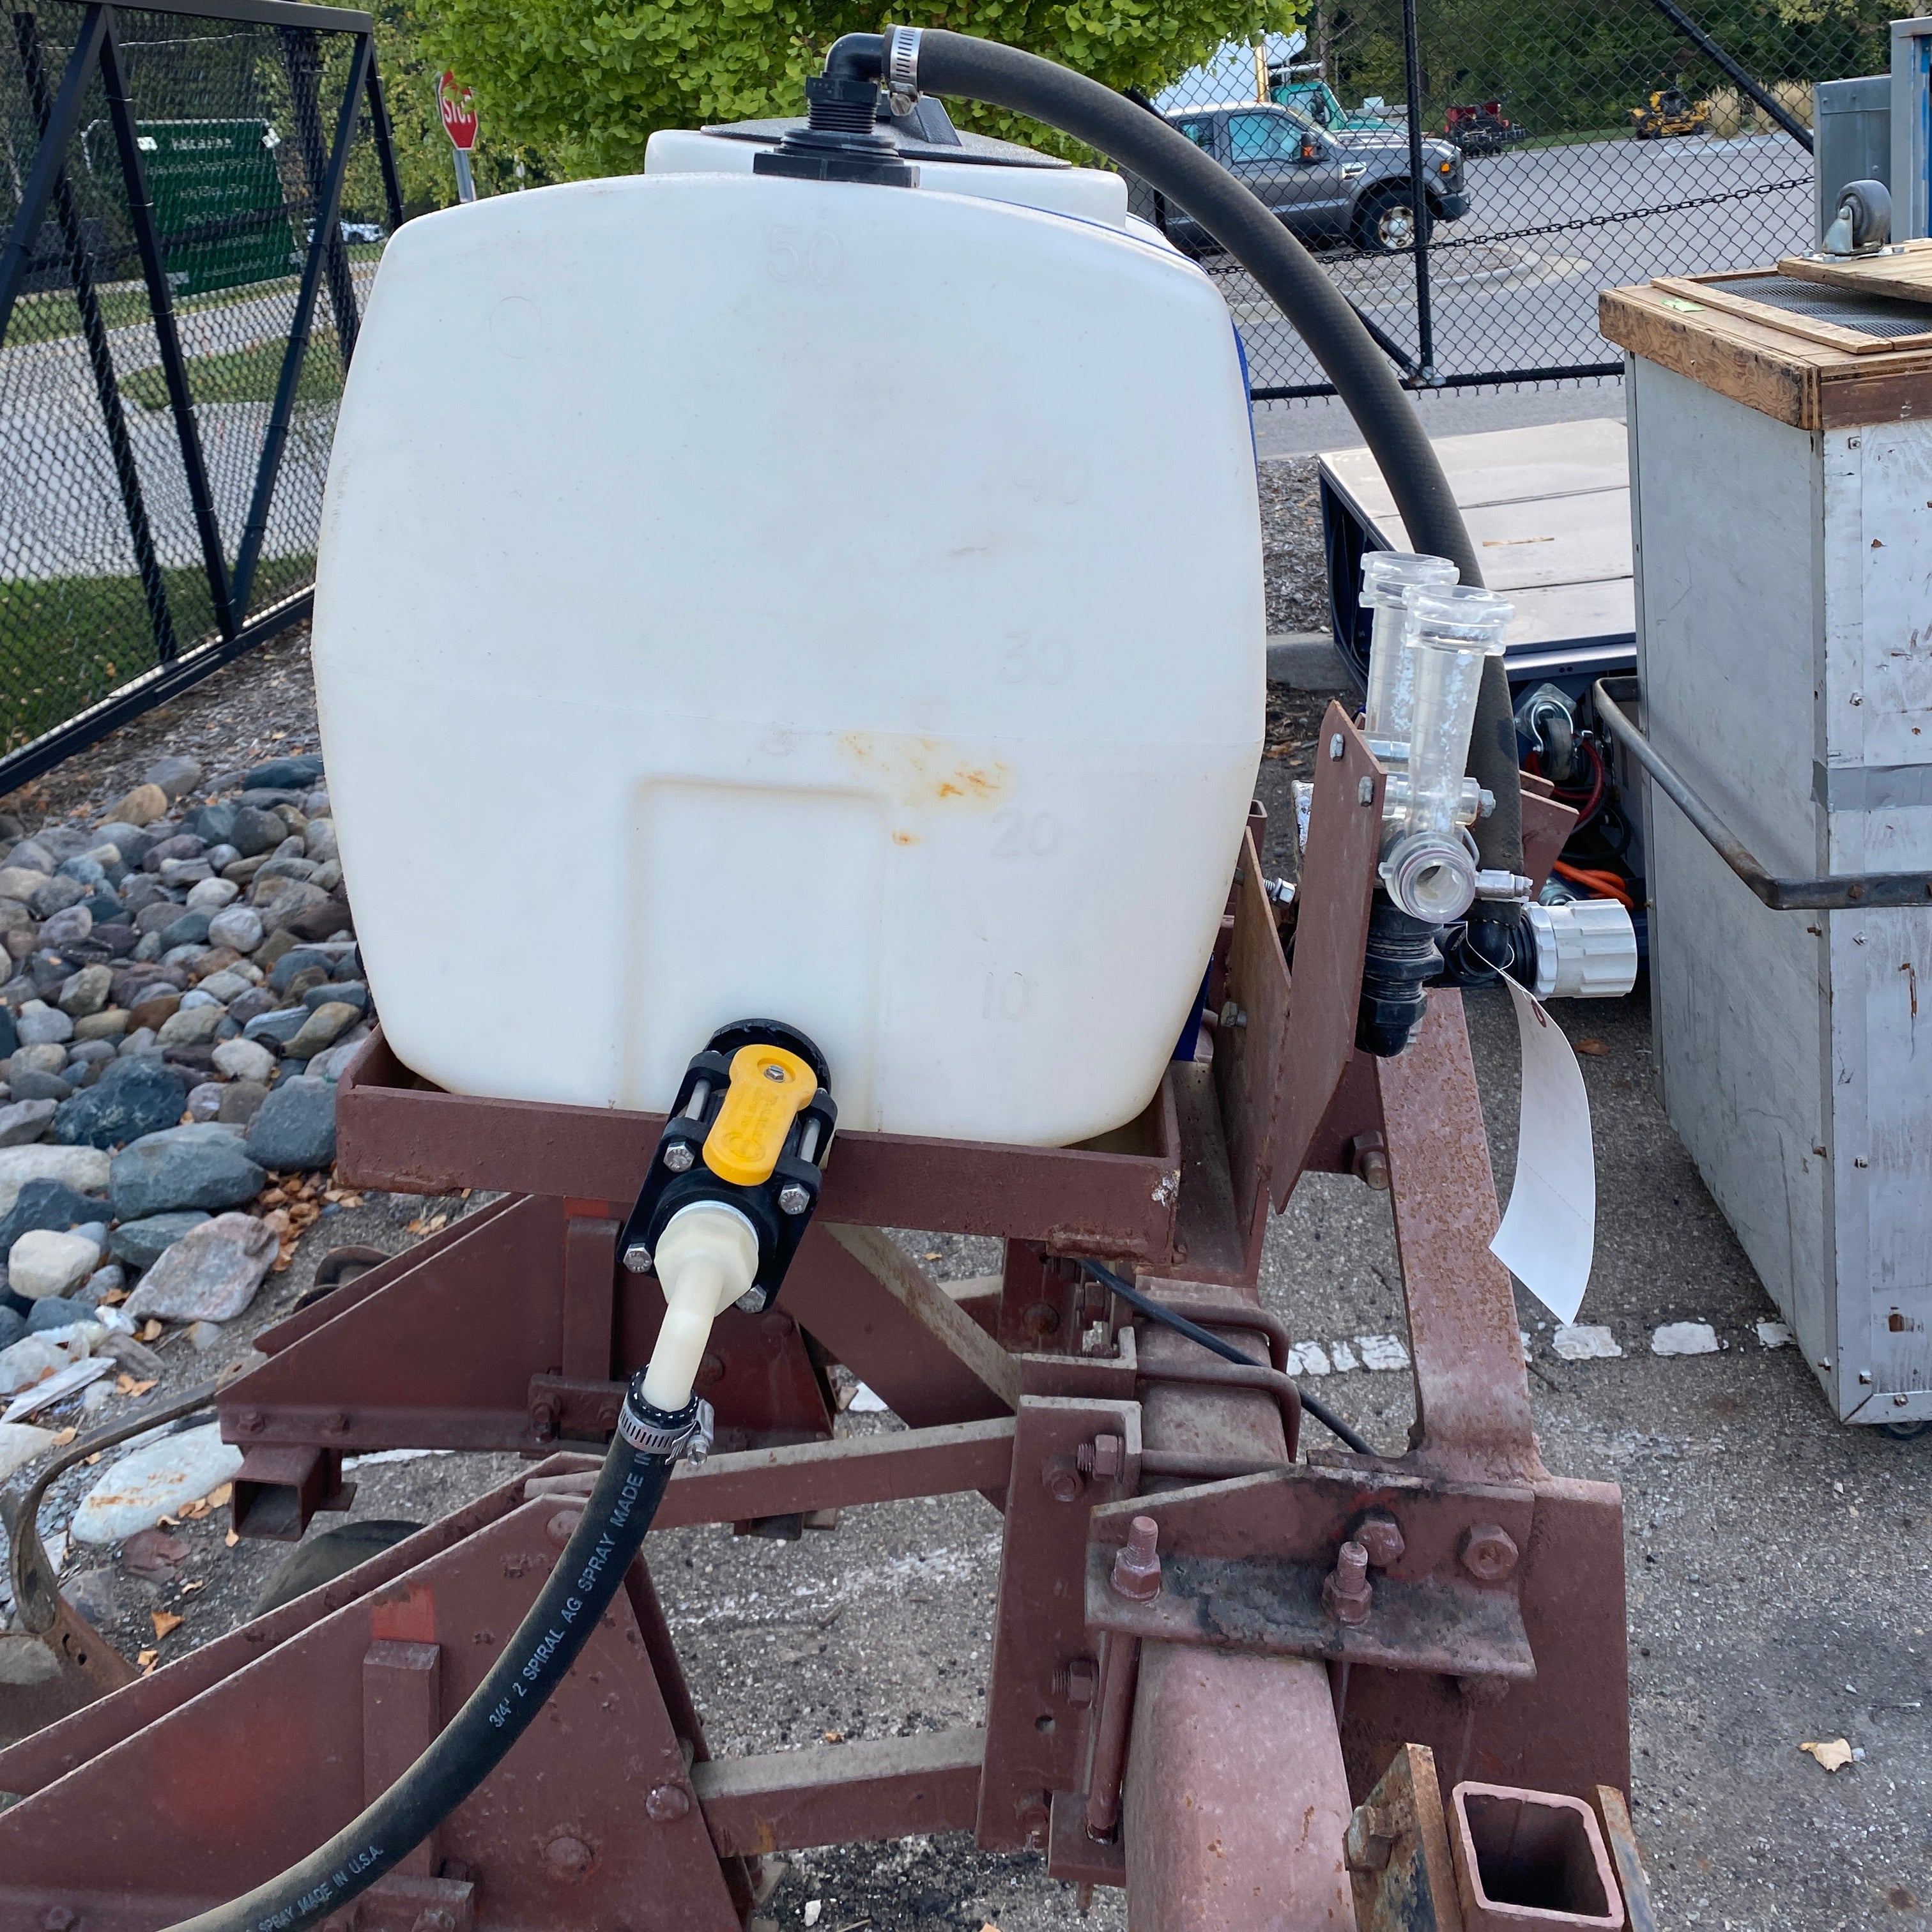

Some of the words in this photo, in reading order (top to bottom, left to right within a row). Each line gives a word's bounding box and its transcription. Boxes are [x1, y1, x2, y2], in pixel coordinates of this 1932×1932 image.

[767, 223, 845, 287] 50
[999, 630, 1073, 685] 30
[990, 806, 1061, 857] 20
[982, 971, 1030, 1021] 10
[512, 1682, 527, 1697] 2
[523, 1629, 565, 1680] SPIRAL
[561, 1597, 583, 1623] AG
[578, 1533, 615, 1591] SPRAY
[610, 1473, 644, 1528] MADE
[259, 1906, 295, 1932] SPRAY
[297, 1882, 333, 1915] MADE
[332, 1871, 349, 1887] IN
